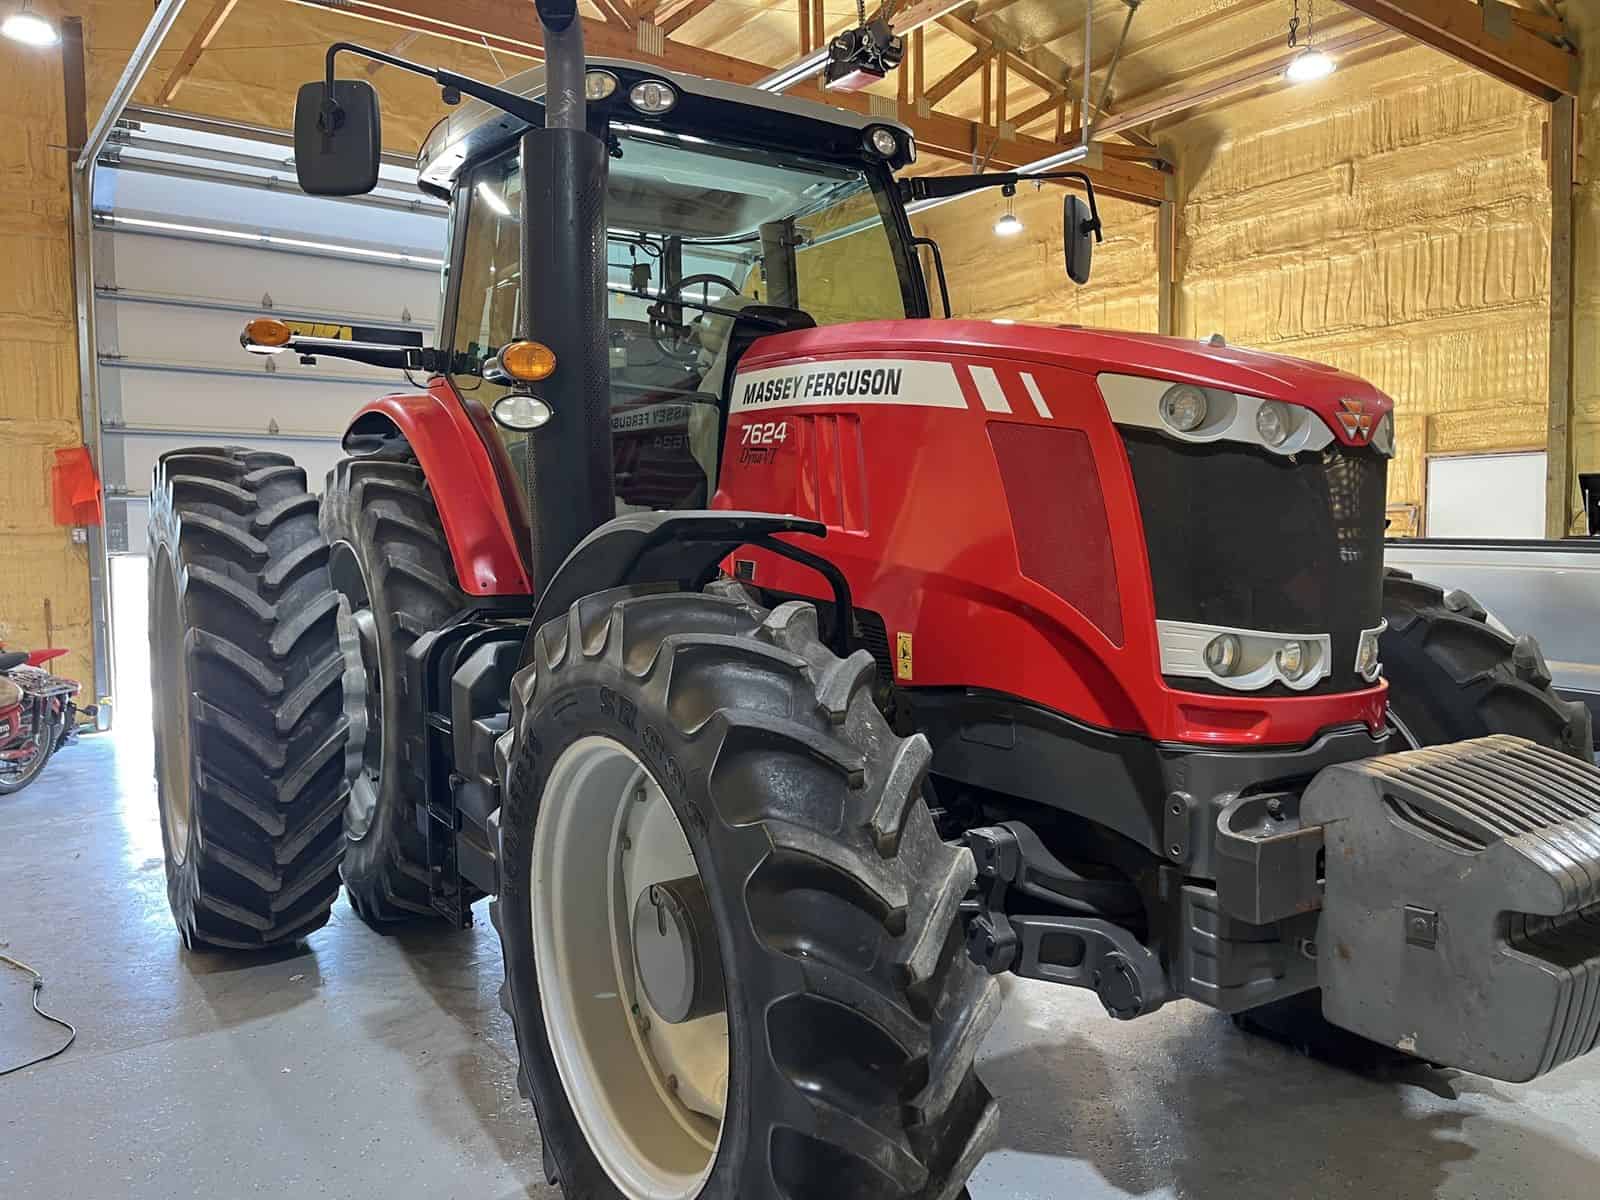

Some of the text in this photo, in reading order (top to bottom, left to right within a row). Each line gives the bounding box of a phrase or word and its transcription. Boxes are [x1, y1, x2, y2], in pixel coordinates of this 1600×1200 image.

[742, 368, 902, 405] MASSEY FERGUSON
[741, 421, 787, 445] 7624
